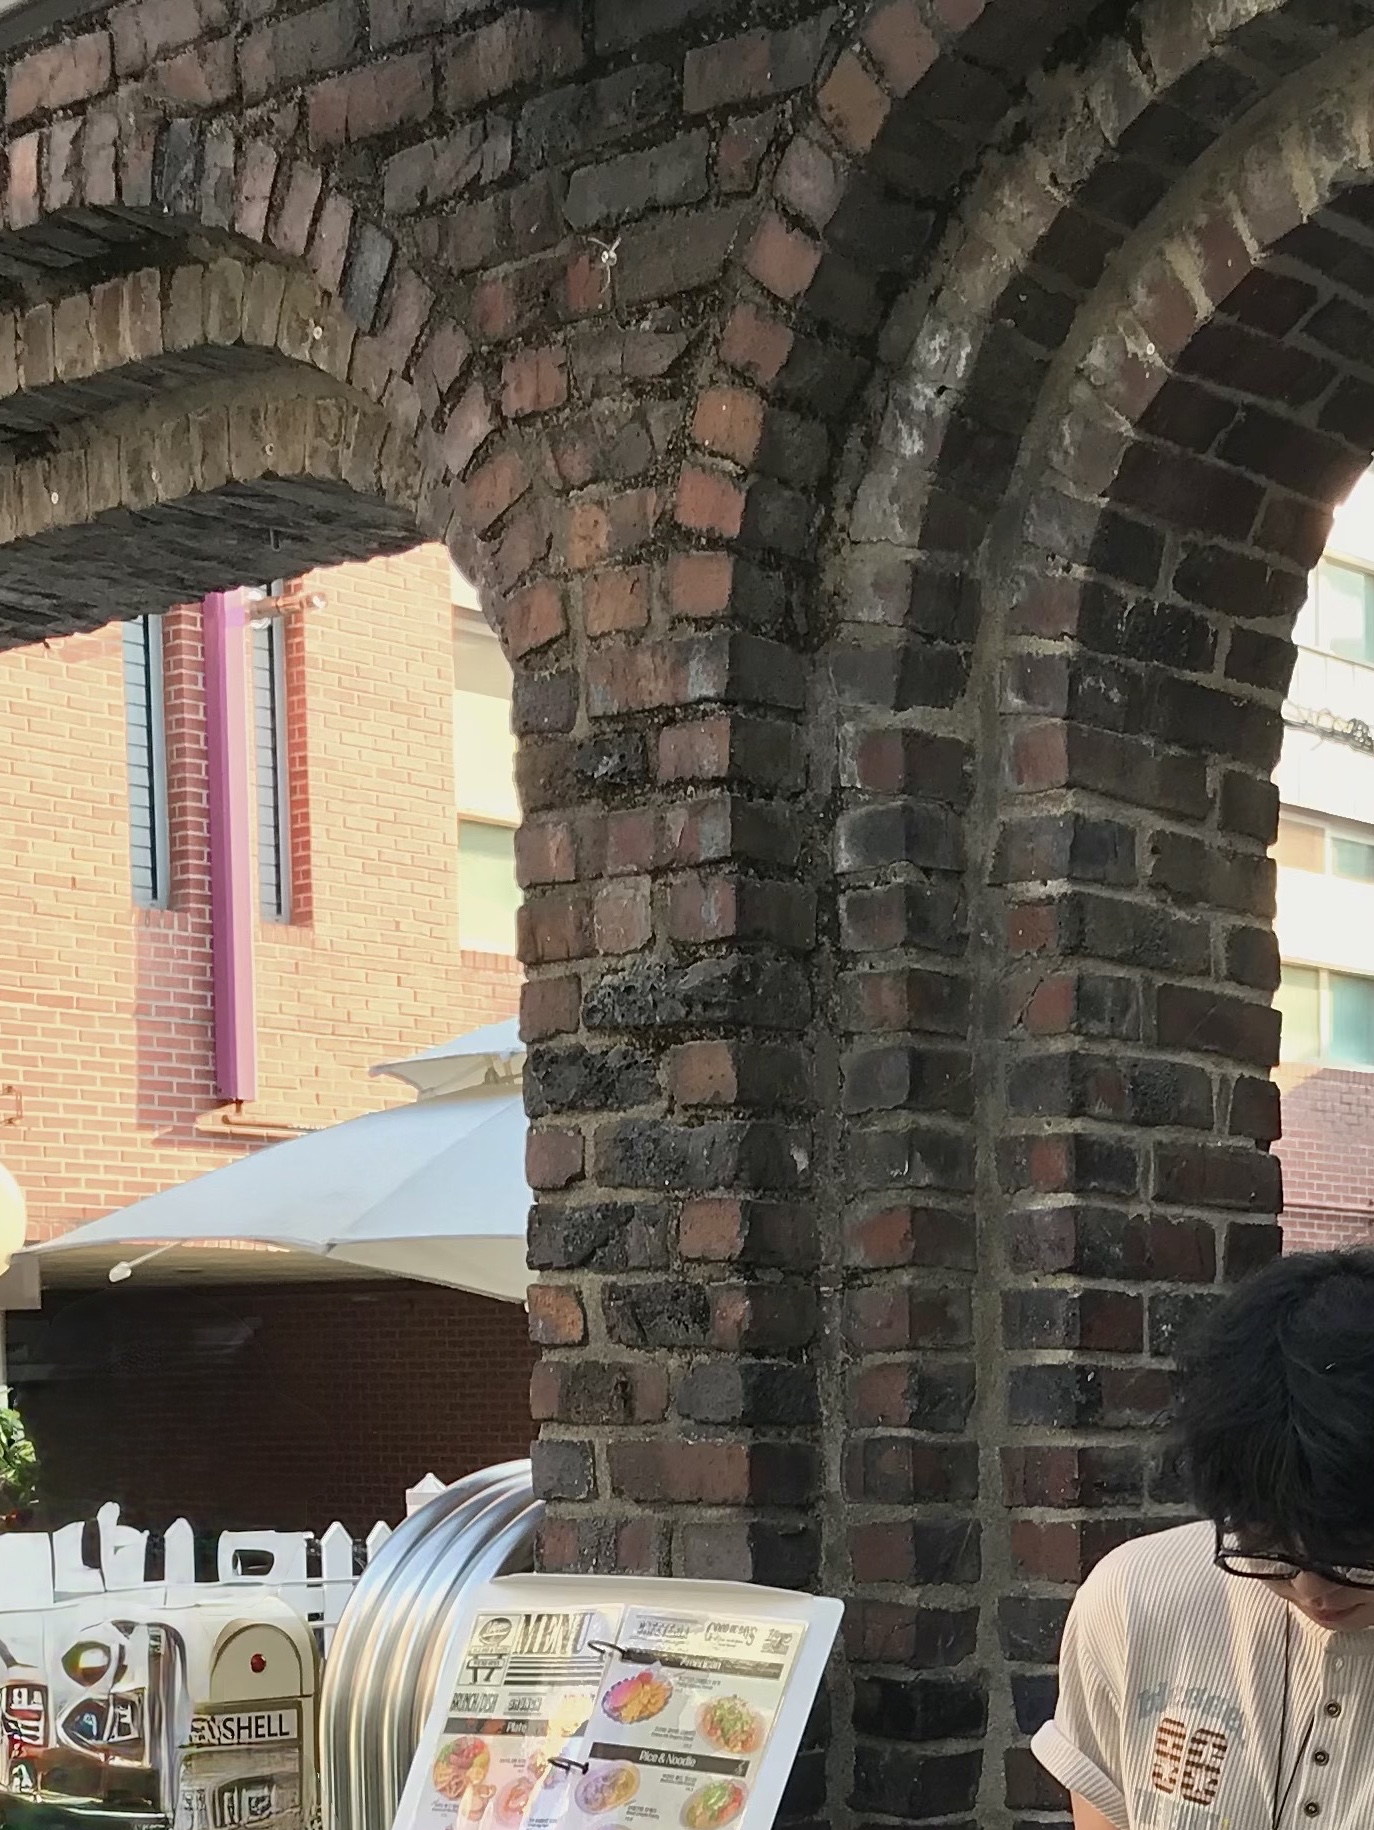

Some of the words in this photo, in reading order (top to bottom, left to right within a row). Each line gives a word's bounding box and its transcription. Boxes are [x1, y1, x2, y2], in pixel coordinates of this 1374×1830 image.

[513, 1613, 594, 1655] MENU
[639, 1750, 658, 1763] Rice
[658, 1753, 666, 1764] &
[667, 1754, 697, 1768] Noodle
